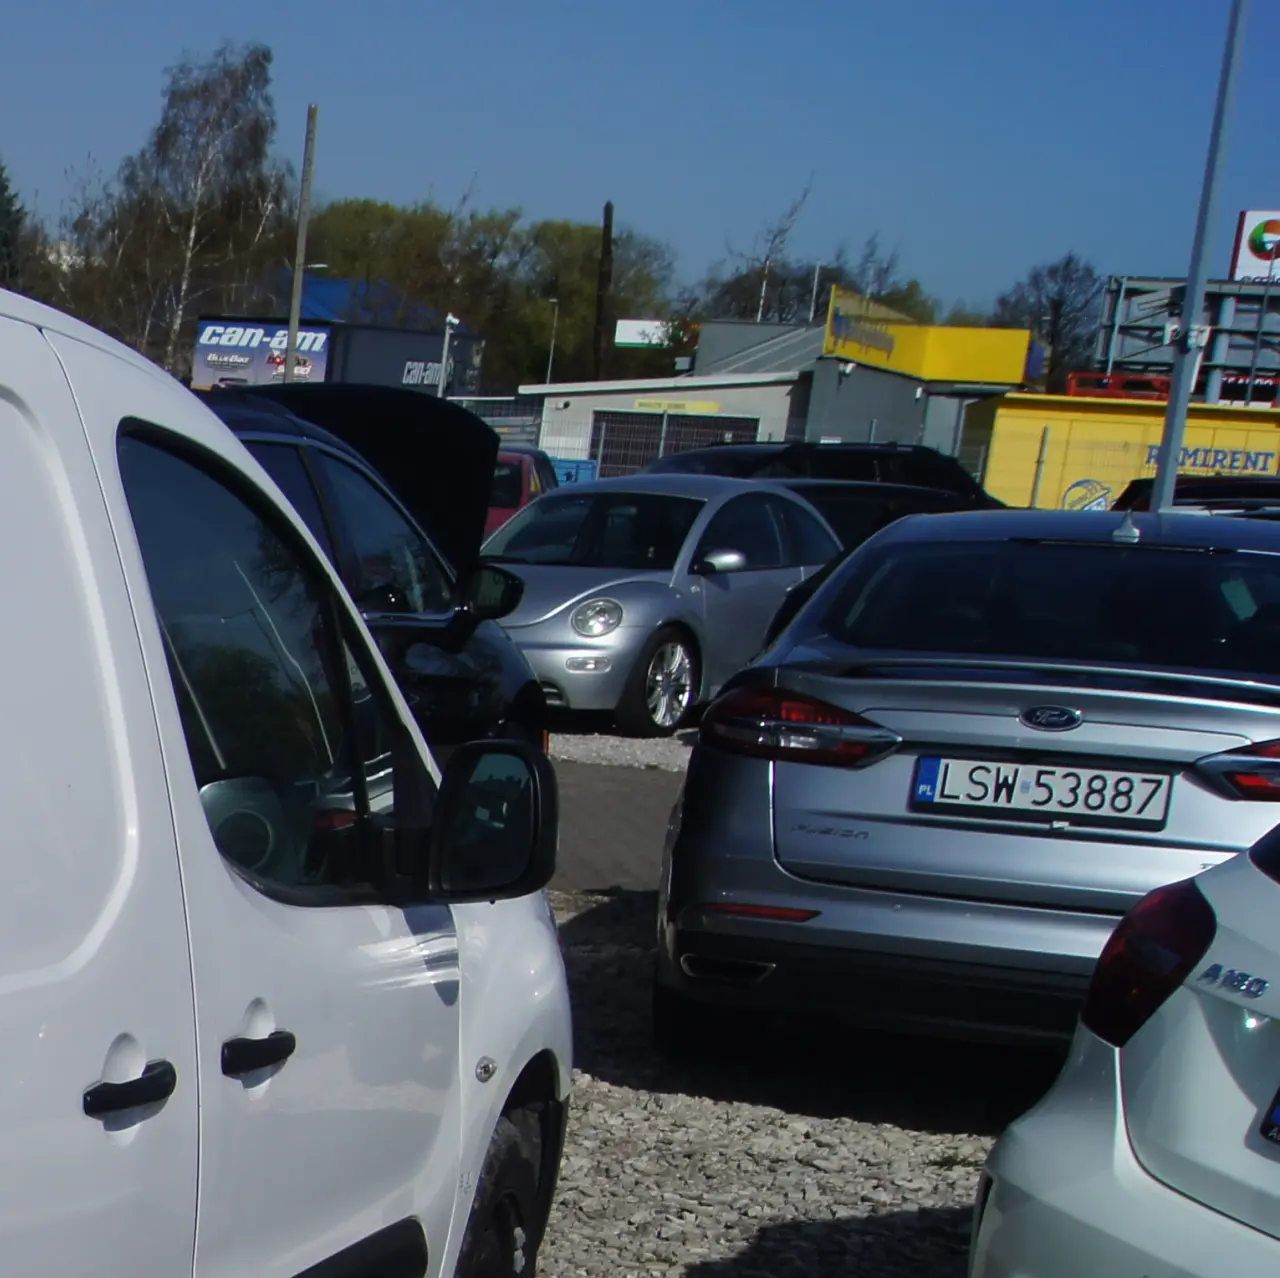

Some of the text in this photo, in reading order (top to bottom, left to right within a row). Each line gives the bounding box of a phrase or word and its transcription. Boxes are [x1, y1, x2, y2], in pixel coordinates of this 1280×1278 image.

[199, 325, 327, 352] can-am
[1145, 444, 1275, 471] RMIRENT
[940, 763, 1020, 804] LSW
[1031, 769, 1164, 815] 53887
